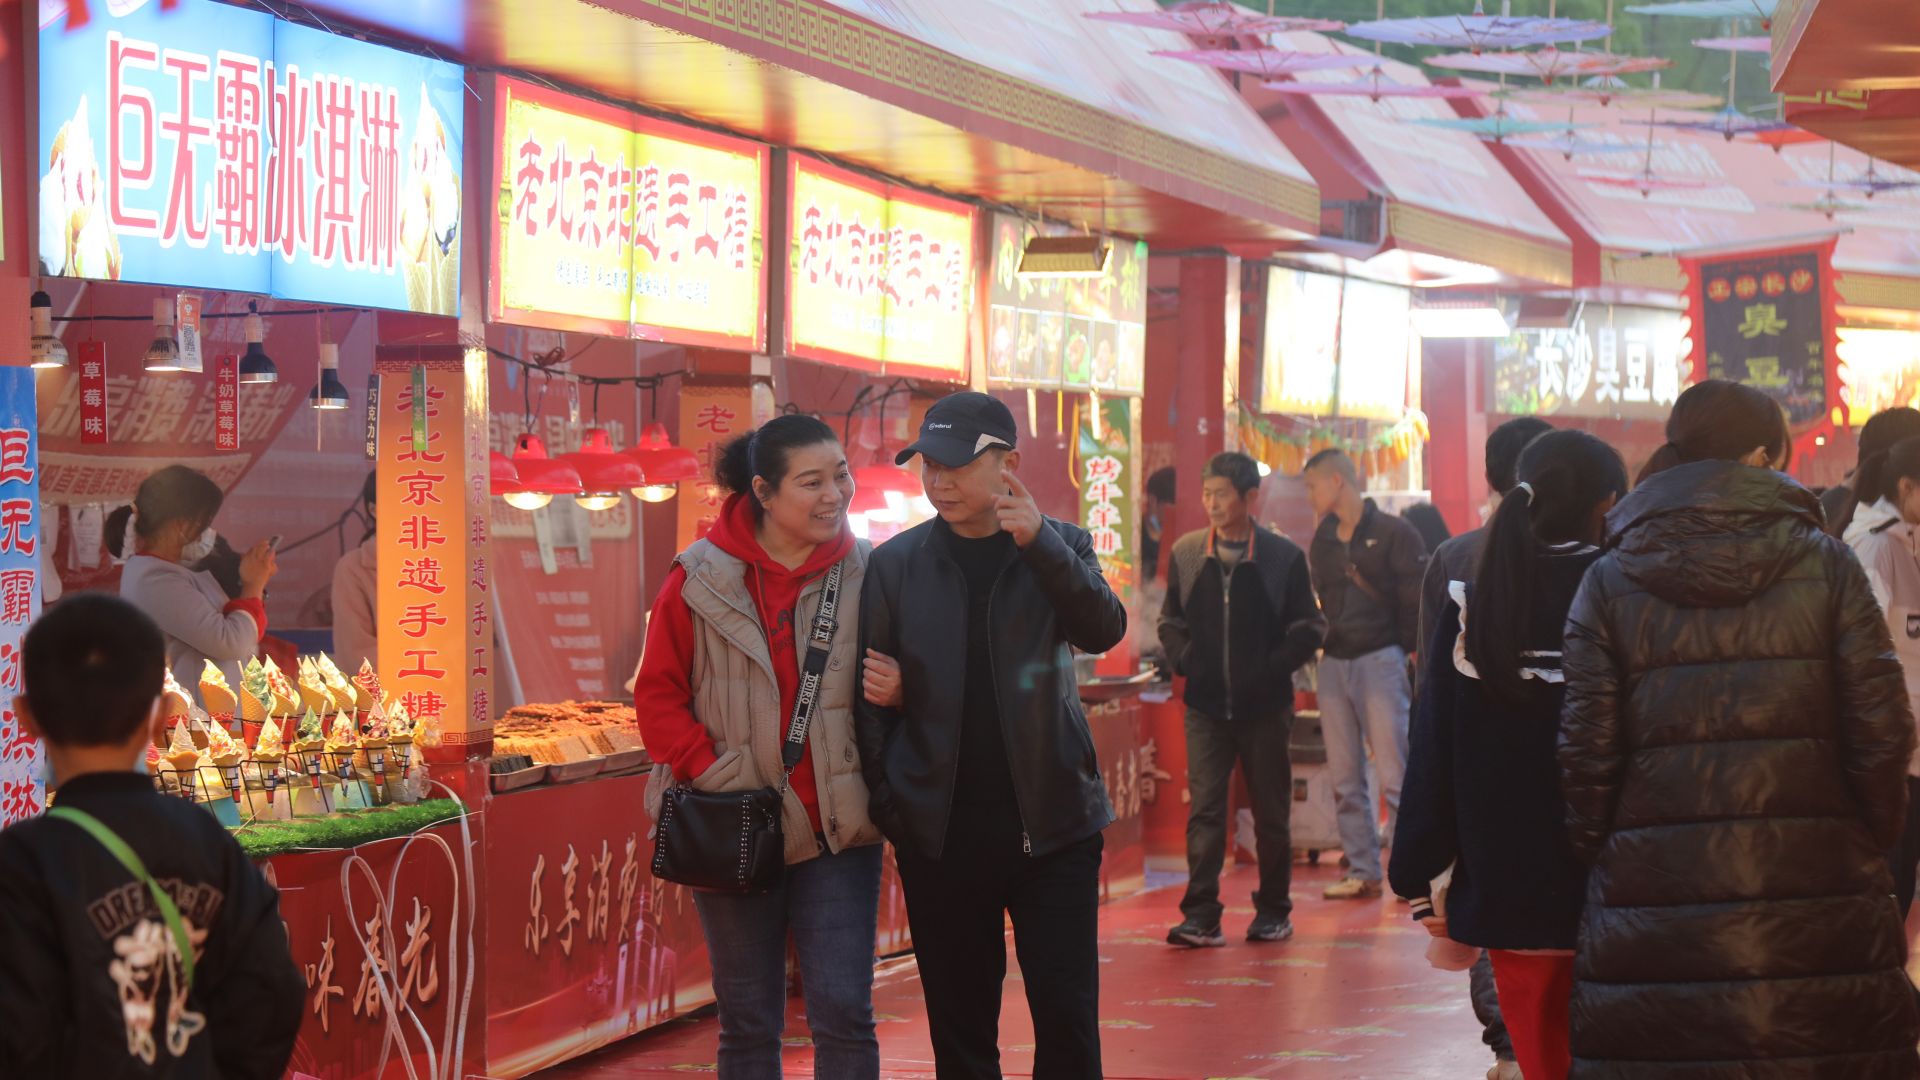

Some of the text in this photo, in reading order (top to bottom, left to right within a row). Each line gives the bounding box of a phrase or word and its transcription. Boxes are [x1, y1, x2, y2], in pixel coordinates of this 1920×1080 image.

[109, 34, 401, 271] 巨无霸冰淇淋
[82, 361, 103, 435] 草莓味
[218, 367, 235, 447] 牛奶草莓味
[366, 388, 377, 457] 巧克力味
[396, 384, 447, 723] 老北京非遗手工糖
[801, 674, 816, 704] DOIRO
[283, 896, 439, 1032] 味春光
